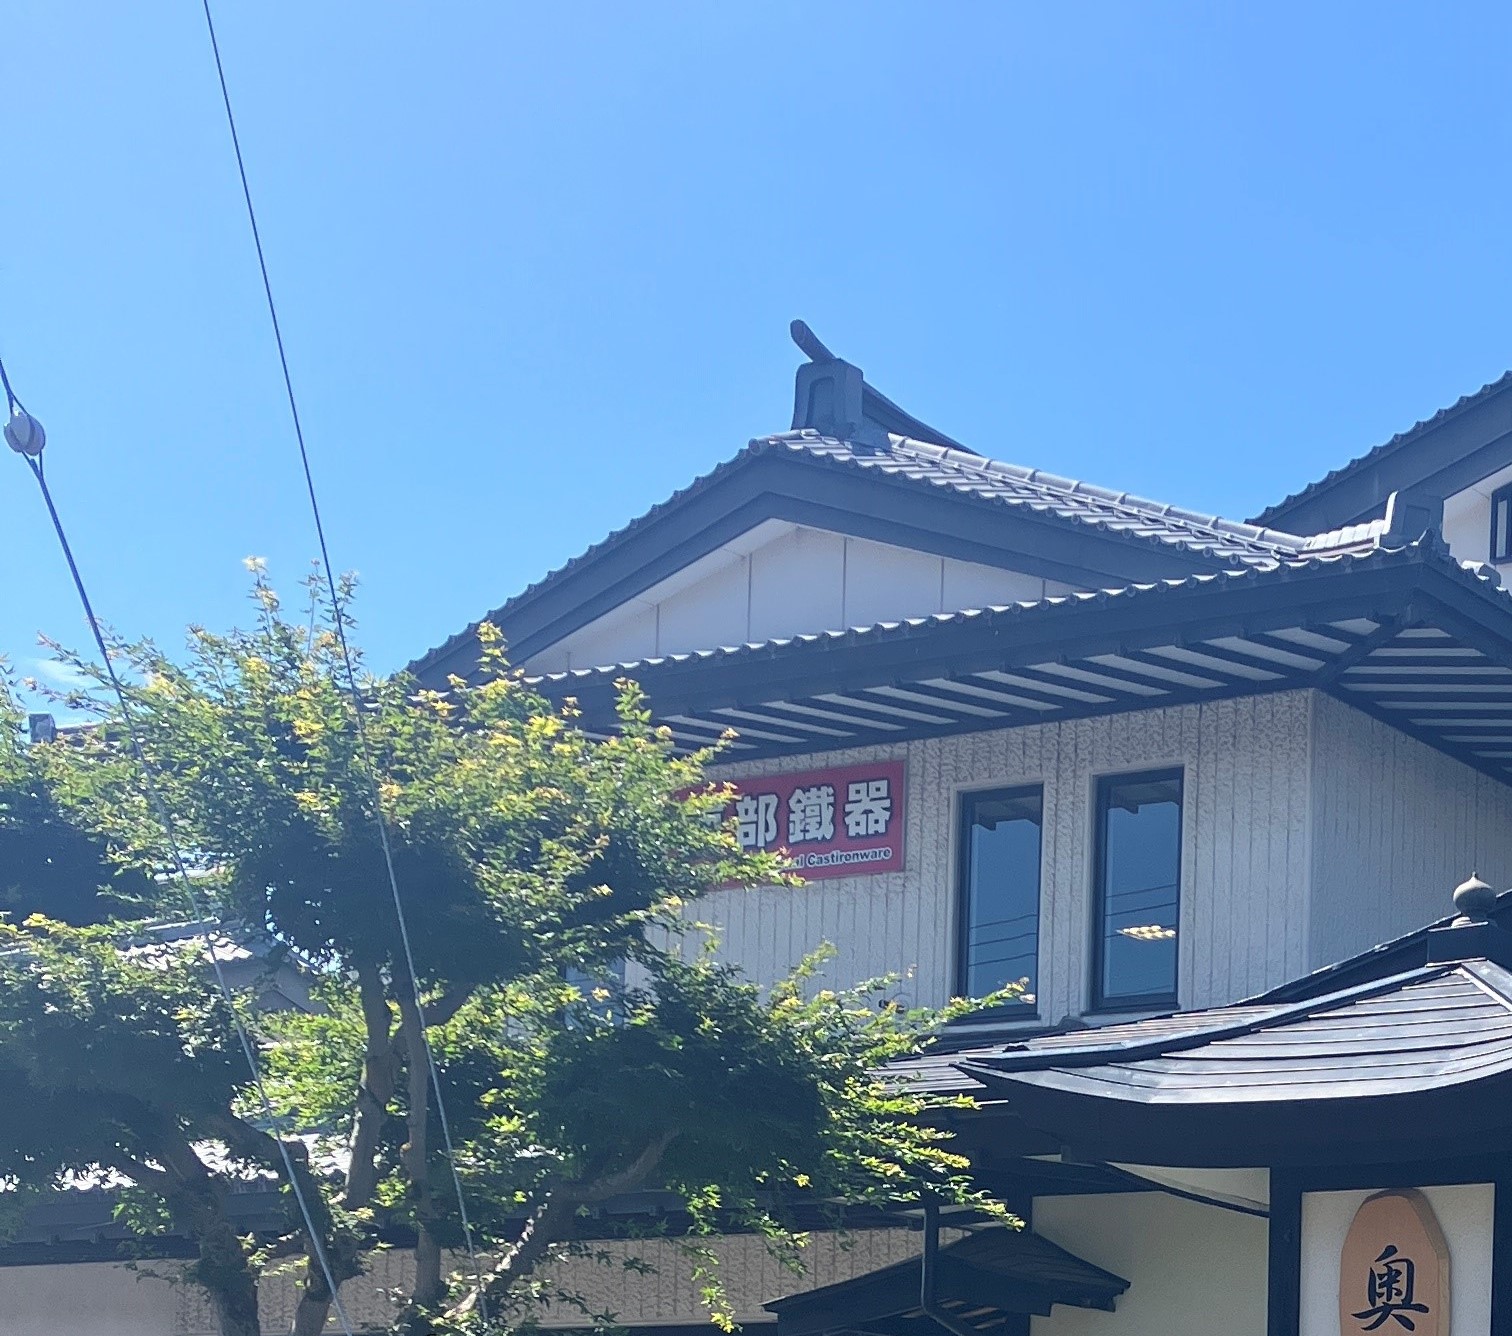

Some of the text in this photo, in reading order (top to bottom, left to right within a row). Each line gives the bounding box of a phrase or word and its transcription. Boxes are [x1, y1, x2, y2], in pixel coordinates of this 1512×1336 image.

[700, 778, 891, 848] 部鐵器
[806, 847, 892, 867] Castironware
